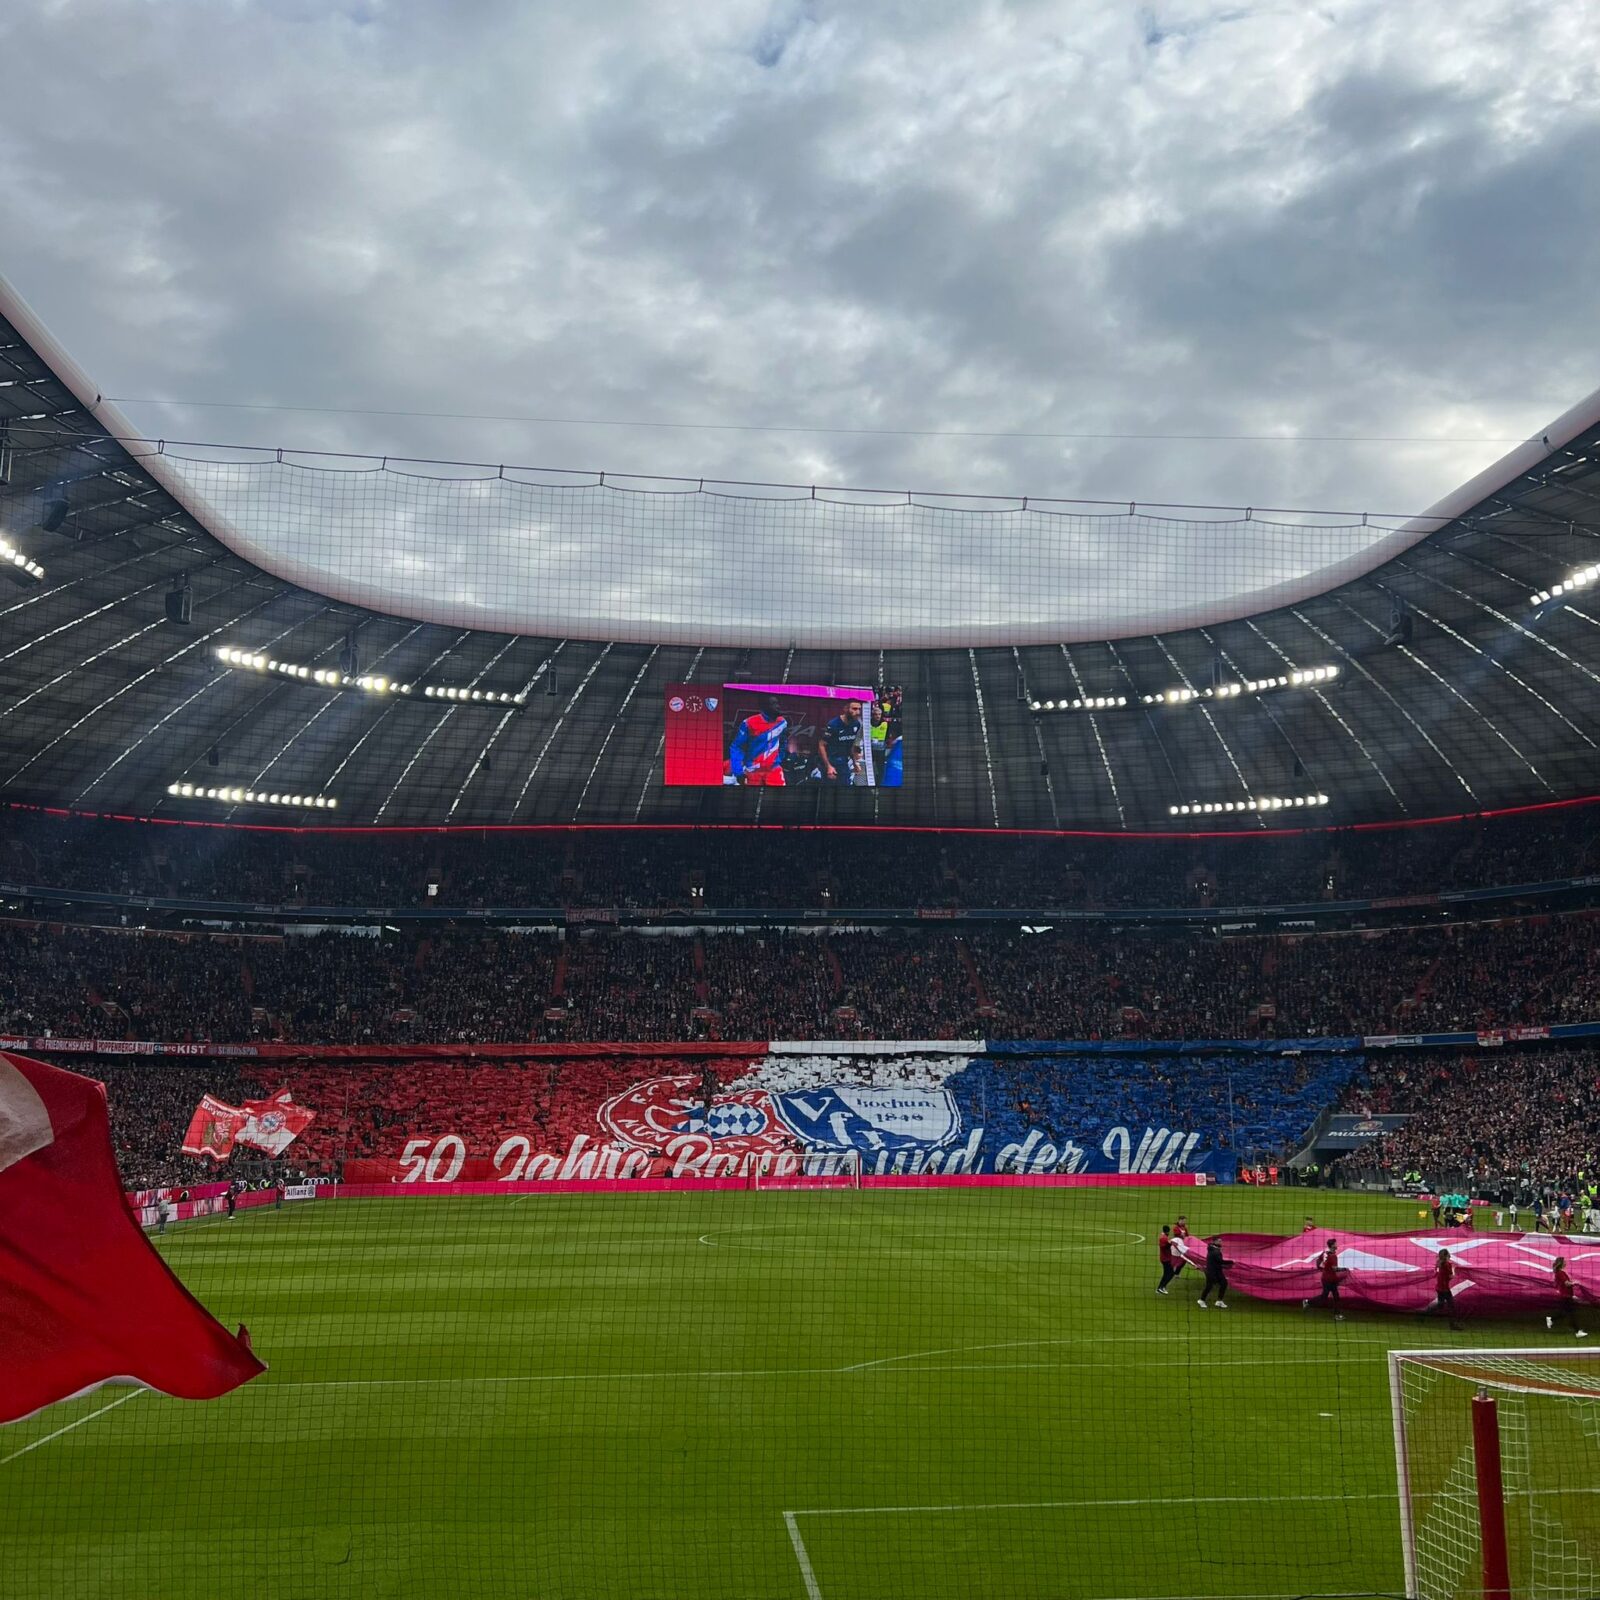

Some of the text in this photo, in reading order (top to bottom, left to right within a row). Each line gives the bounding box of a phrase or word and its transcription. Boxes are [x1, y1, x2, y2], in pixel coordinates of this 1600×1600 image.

[177, 1045, 207, 1054] KIST
[392, 1134, 466, 1183] 50
[494, 1134, 652, 1181] Jahre
[286, 1187, 307, 1197] Allianz
